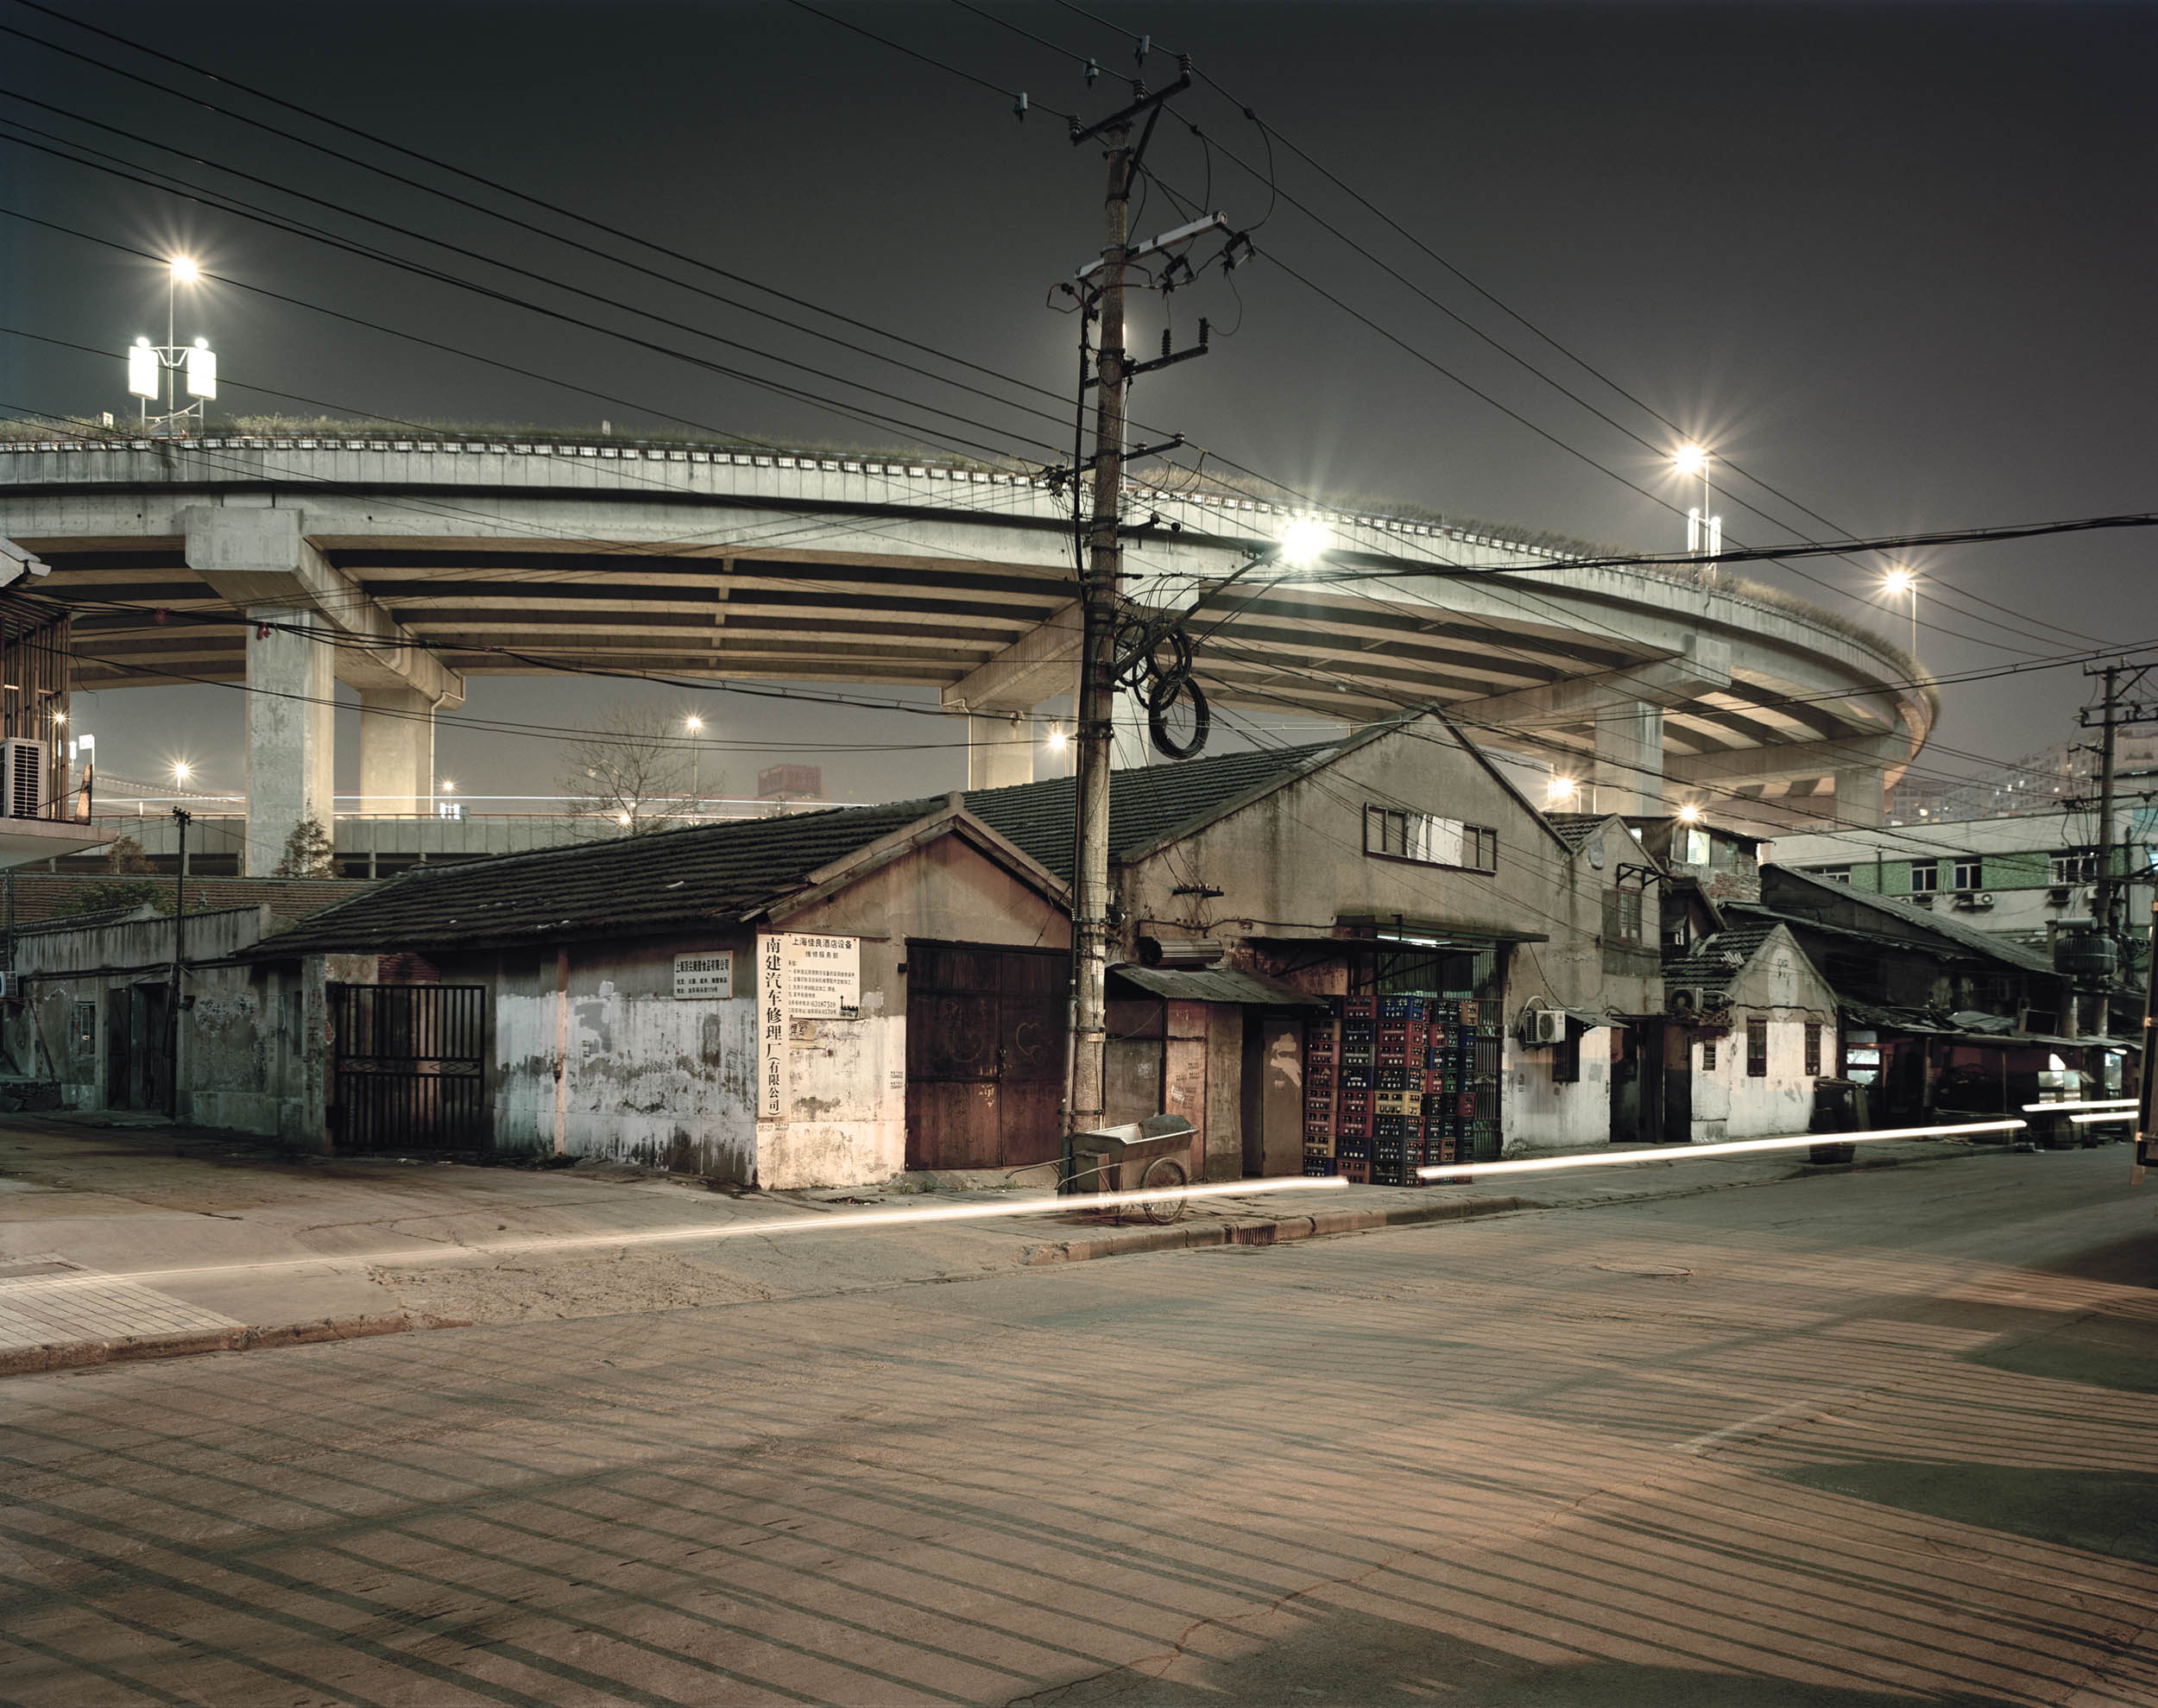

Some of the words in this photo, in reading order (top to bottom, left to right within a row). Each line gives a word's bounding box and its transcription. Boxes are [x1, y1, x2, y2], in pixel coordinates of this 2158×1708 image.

[792, 937, 853, 950] 上海佳良酒店设备
[766, 937, 781, 1115] 南建汽车修理厂(有限公司)
